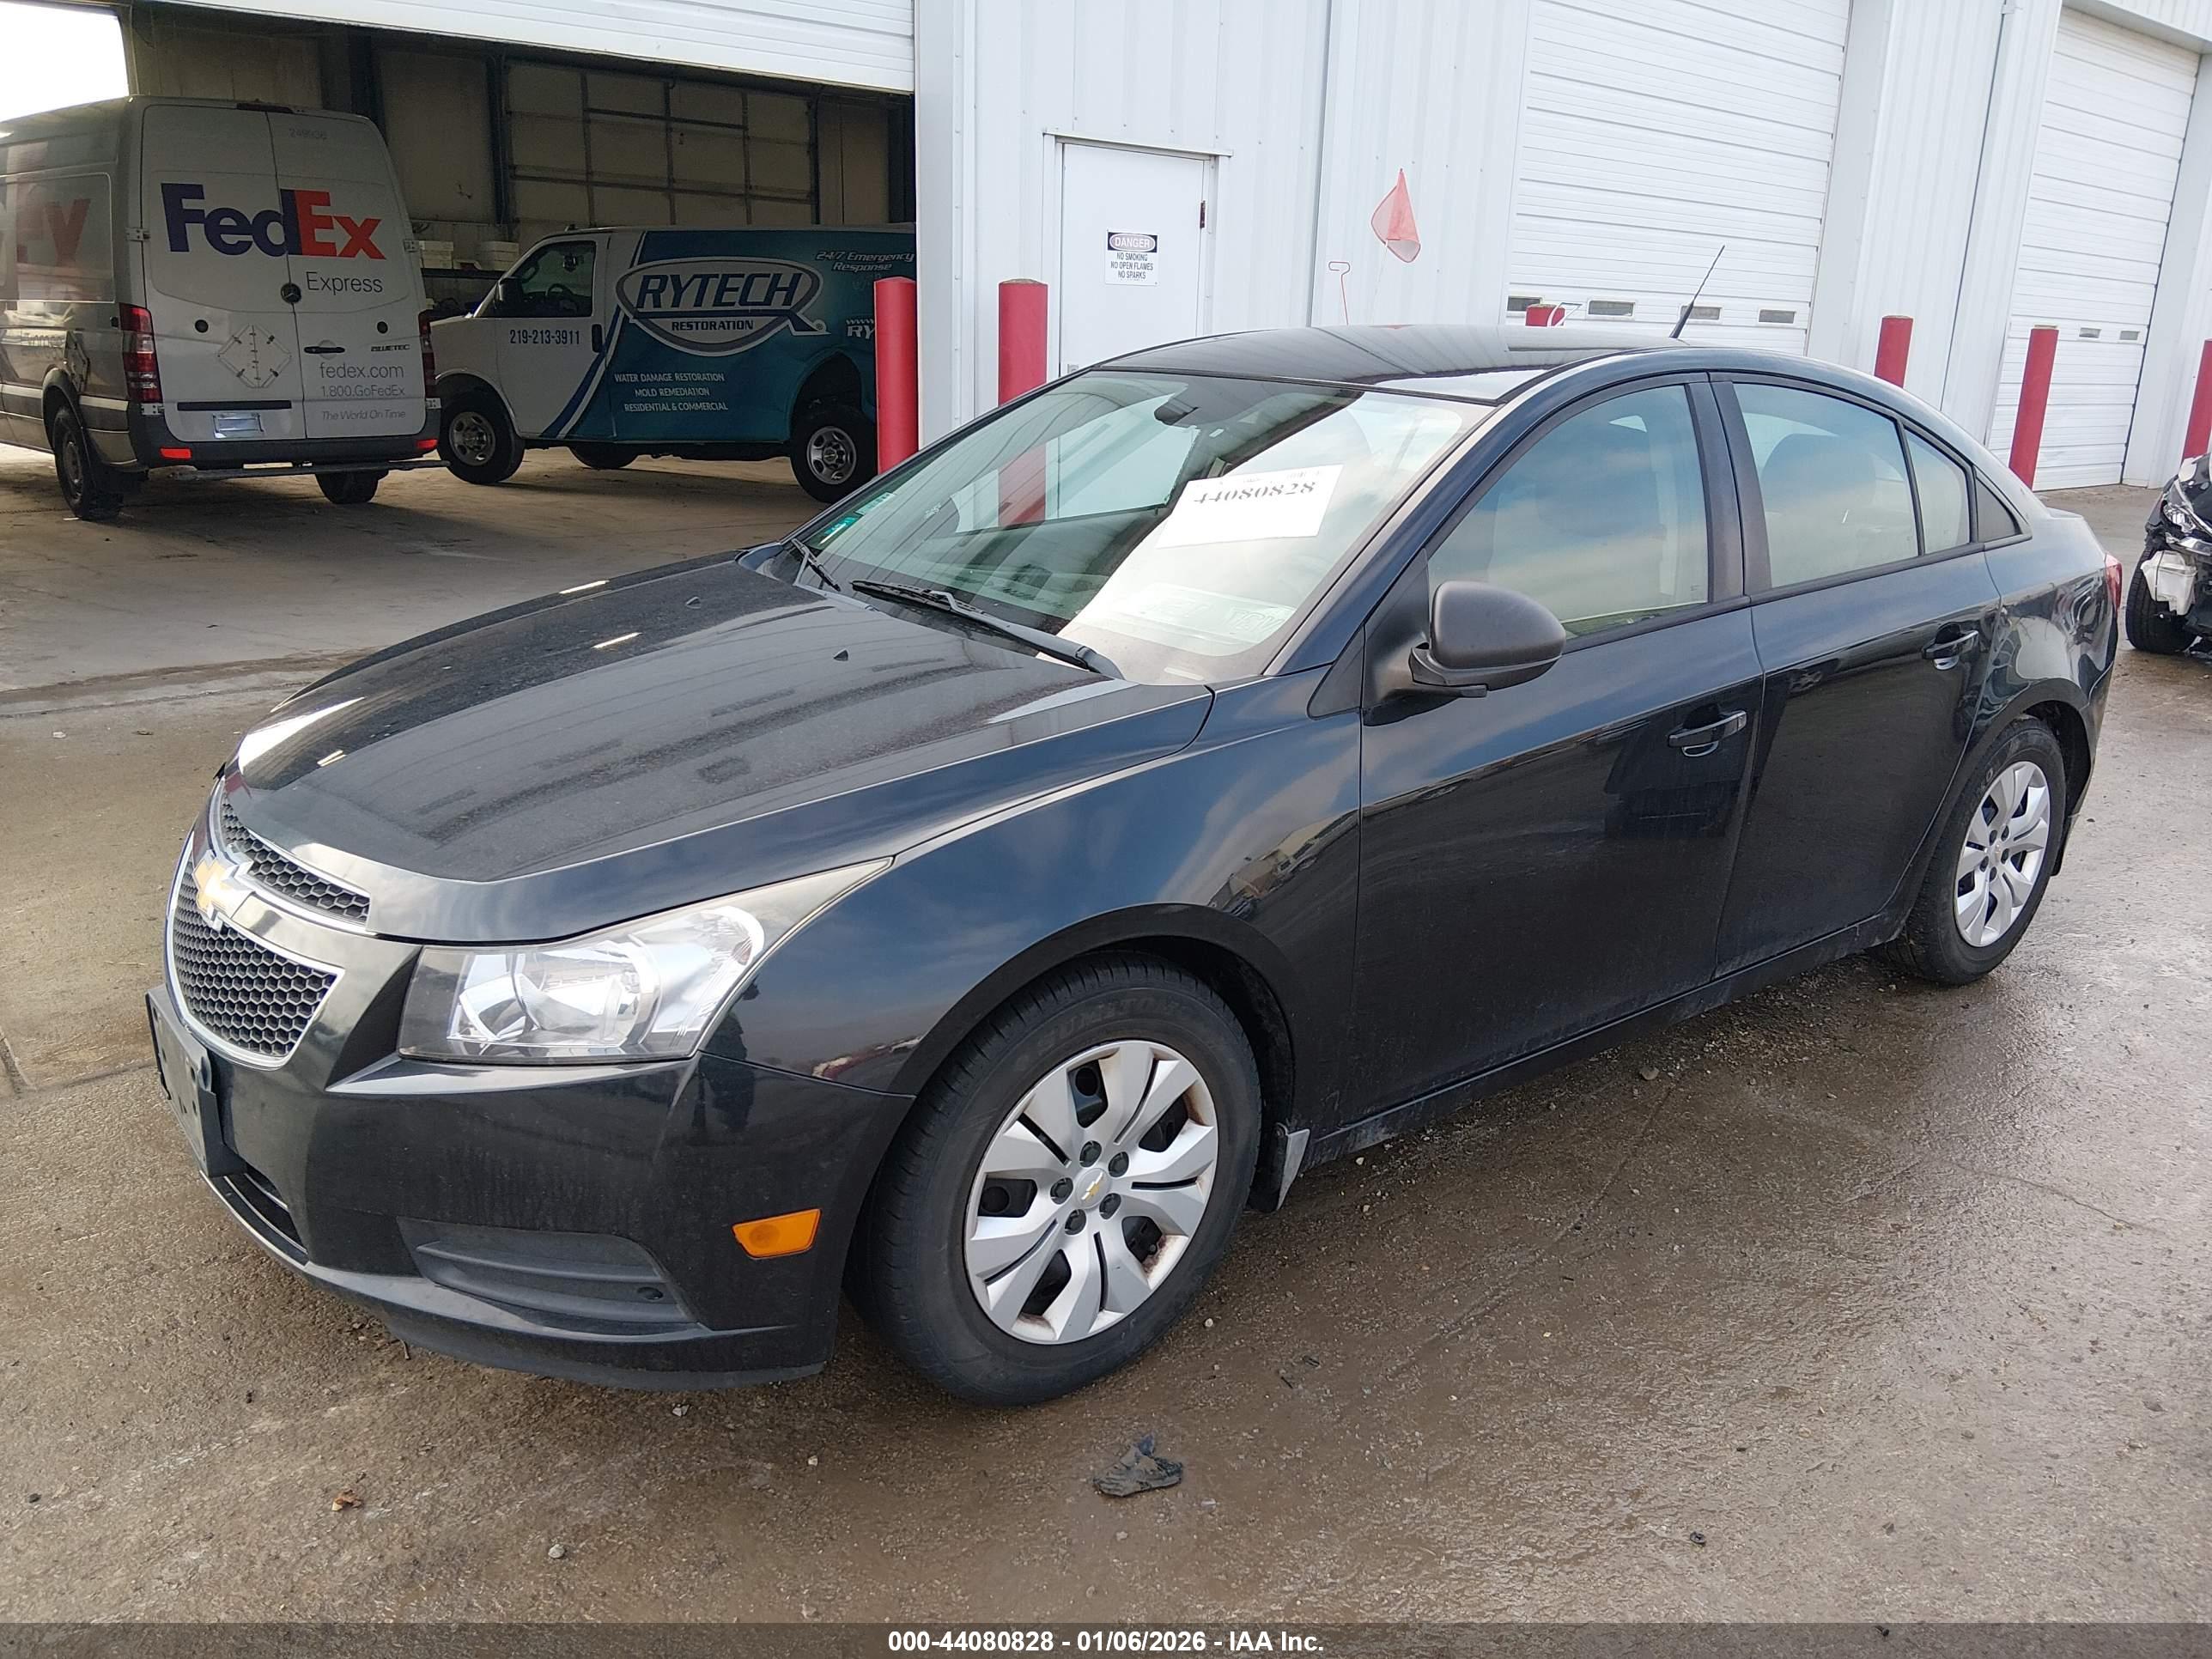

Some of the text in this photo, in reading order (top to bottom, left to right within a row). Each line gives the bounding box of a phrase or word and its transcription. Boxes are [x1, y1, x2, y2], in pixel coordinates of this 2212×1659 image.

[161, 182, 386, 260] FedEx
[1115, 237, 1150, 248] DANGER
[817, 252, 914, 264] 24/7 Emergency
[1125, 252, 1148, 261] SMOKING
[833, 261, 891, 273] Response
[1133, 262, 1153, 270] FLAMES
[1117, 270, 1146, 279] NO SPARKS
[306, 271, 383, 295] Express
[636, 272, 804, 309] RYTECH
[672, 319, 753, 331] RESTORATION
[509, 329, 580, 345] 219-213-3911
[319, 362, 404, 380] fedex.com
[615, 373, 725, 383] WATER DAMAGE RESTORATION
[320, 385, 405, 398] 1.800.GoFedEx
[635, 387, 709, 398] MOLD REMEDIATION
[624, 403, 728, 412] RESIDENTIAL & COMMERCIAL
[321, 409, 406, 420] The World On Time
[1194, 482, 1316, 504] 44080828
